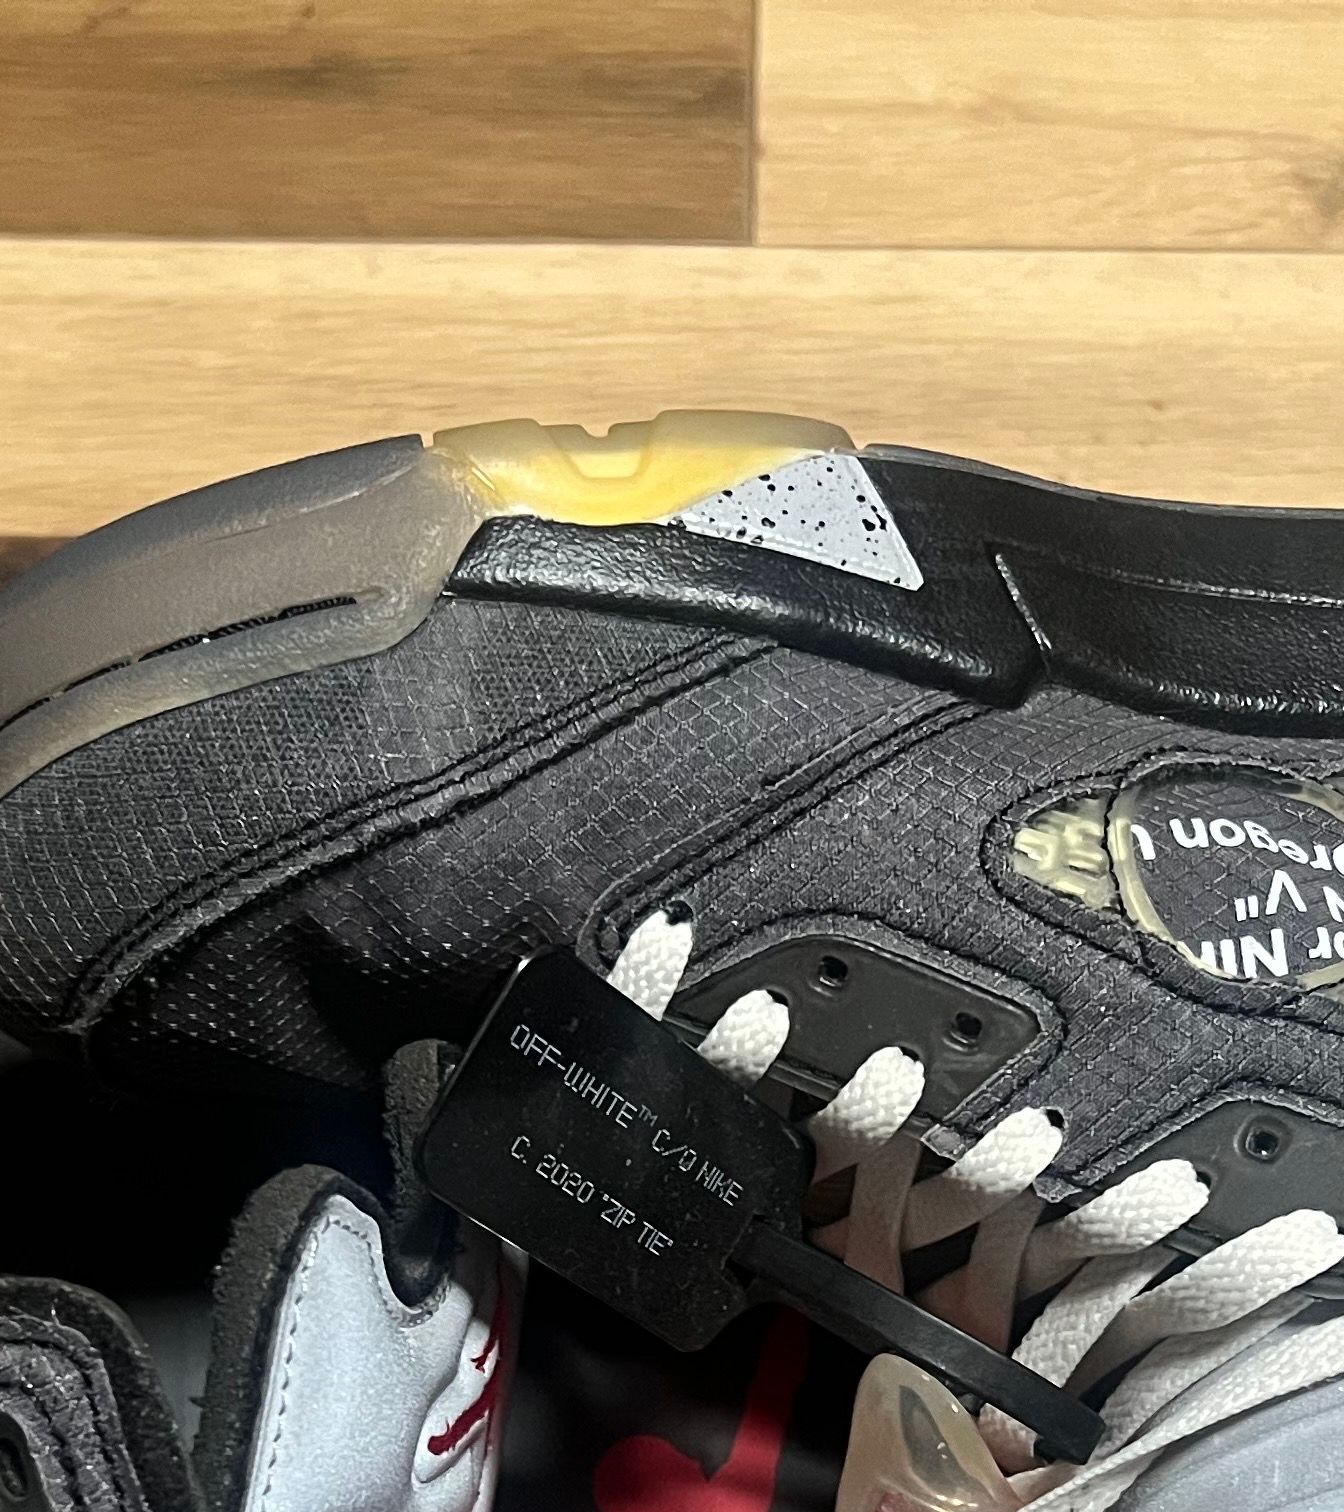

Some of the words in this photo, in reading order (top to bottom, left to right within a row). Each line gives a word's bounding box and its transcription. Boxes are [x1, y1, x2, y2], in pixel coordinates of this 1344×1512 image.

[1234, 869, 1308, 922] V"
[510, 1135, 531, 1165] C.
[534, 1152, 596, 1204] 2020
[694, 1160, 745, 1208] NIKE
